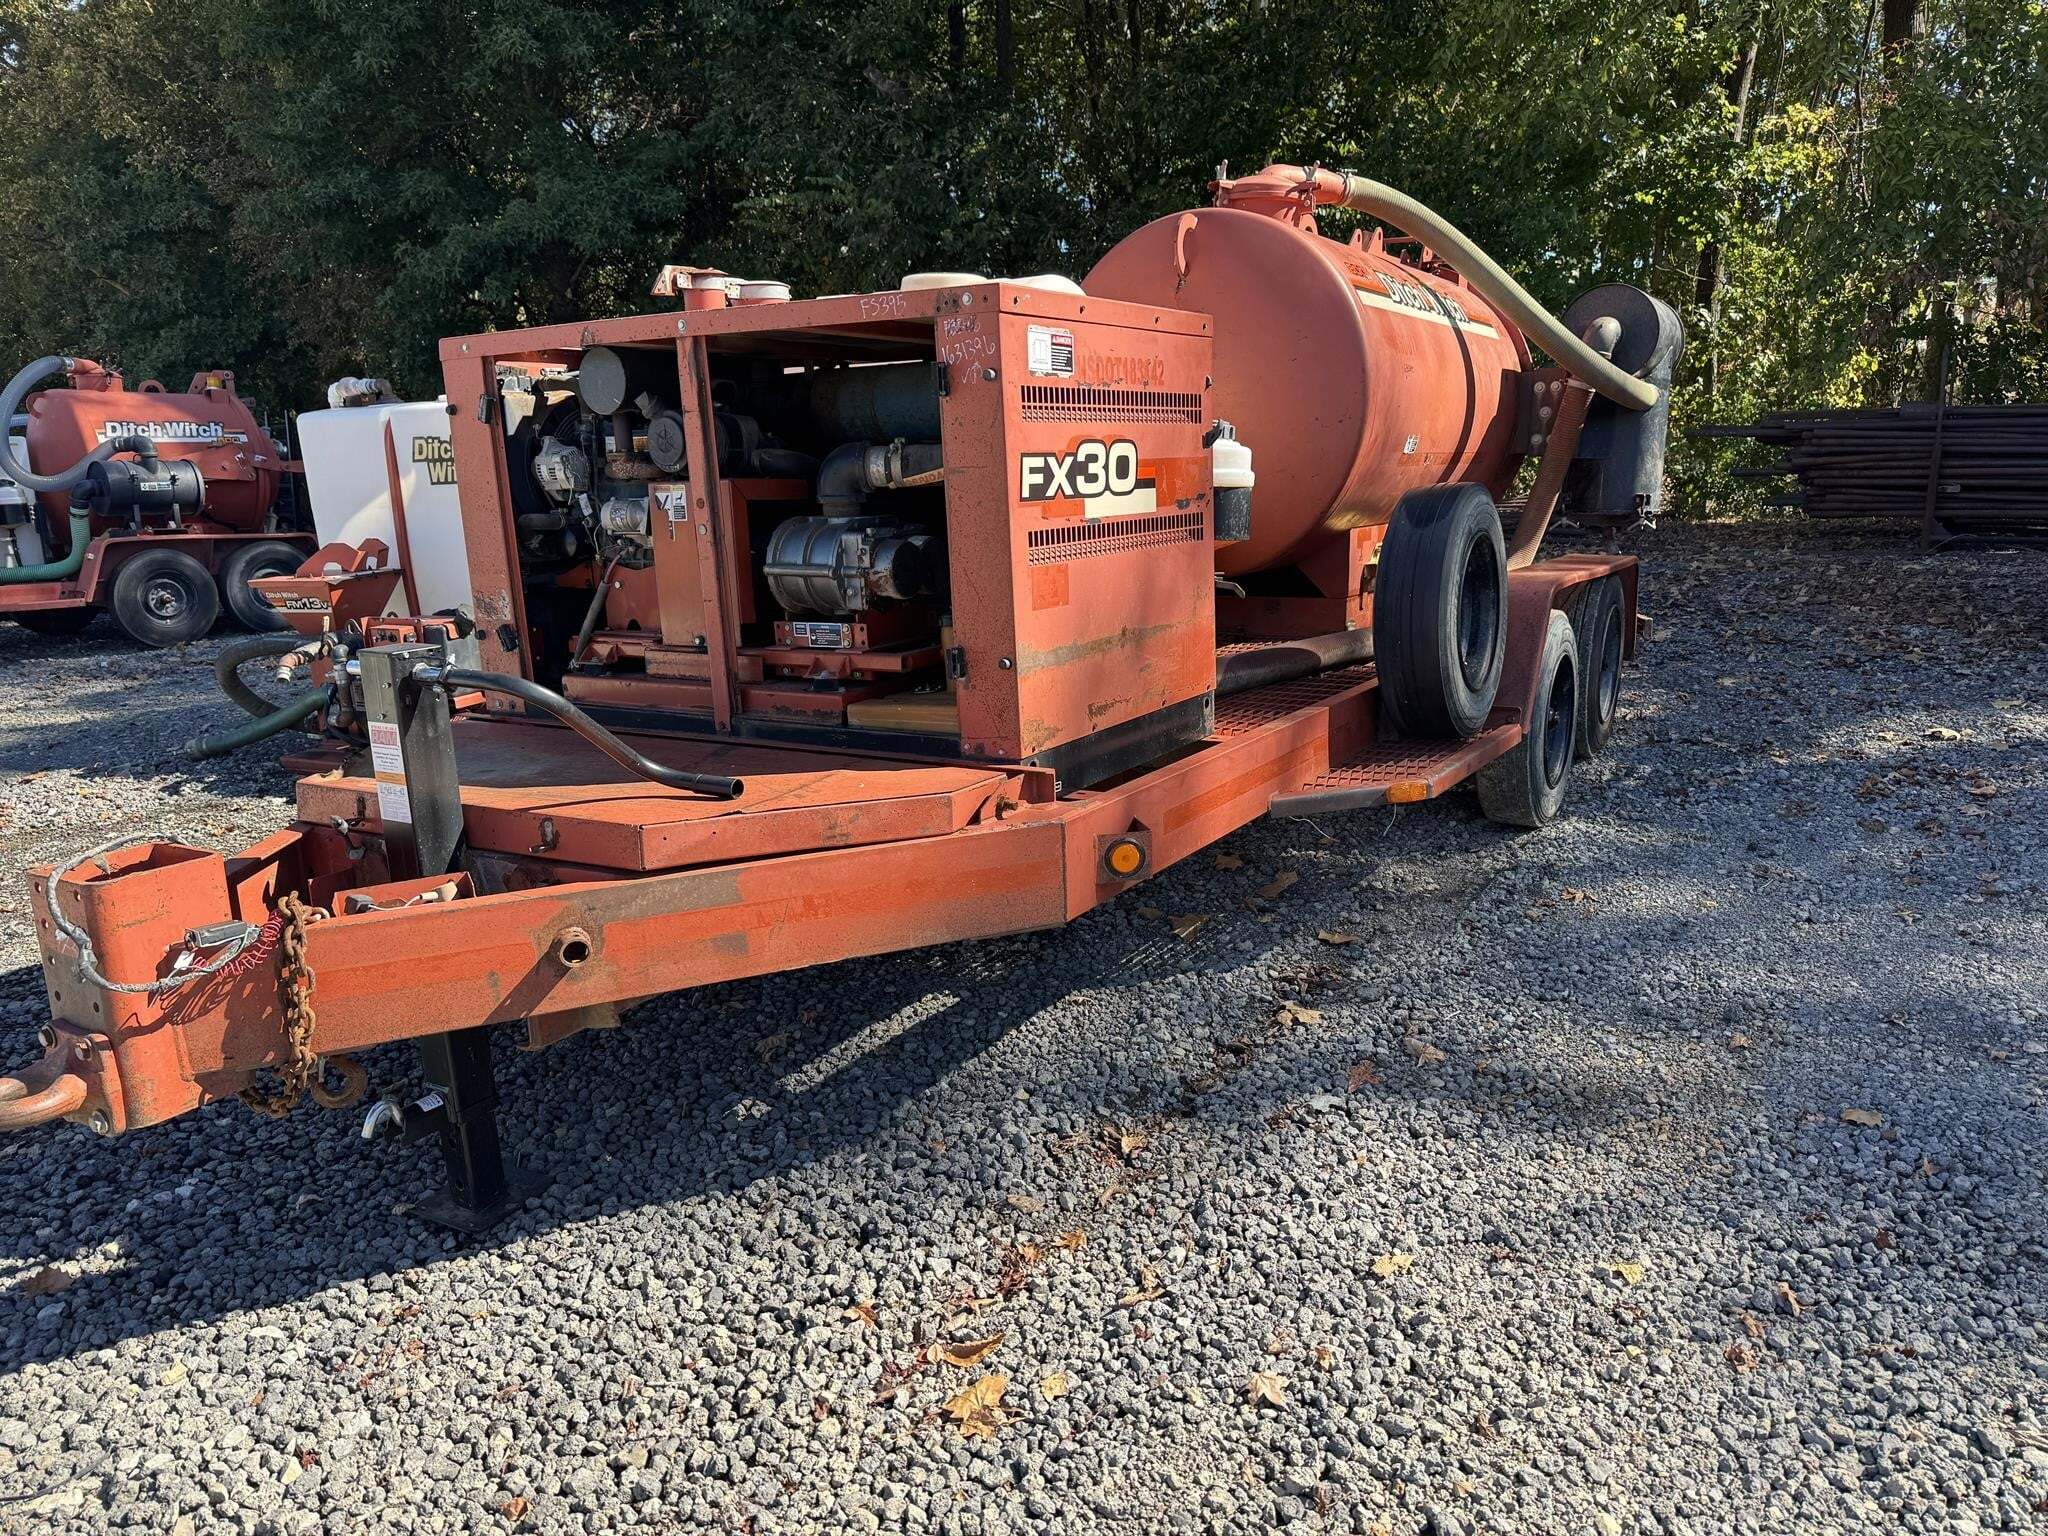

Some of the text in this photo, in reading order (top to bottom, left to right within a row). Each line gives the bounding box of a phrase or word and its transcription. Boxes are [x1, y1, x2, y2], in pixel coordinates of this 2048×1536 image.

[860, 295, 906, 318] FS395
[104, 421, 223, 438] Ditch Witch
[413, 437, 452, 461] Ditc
[1021, 440, 1137, 500] FX30
